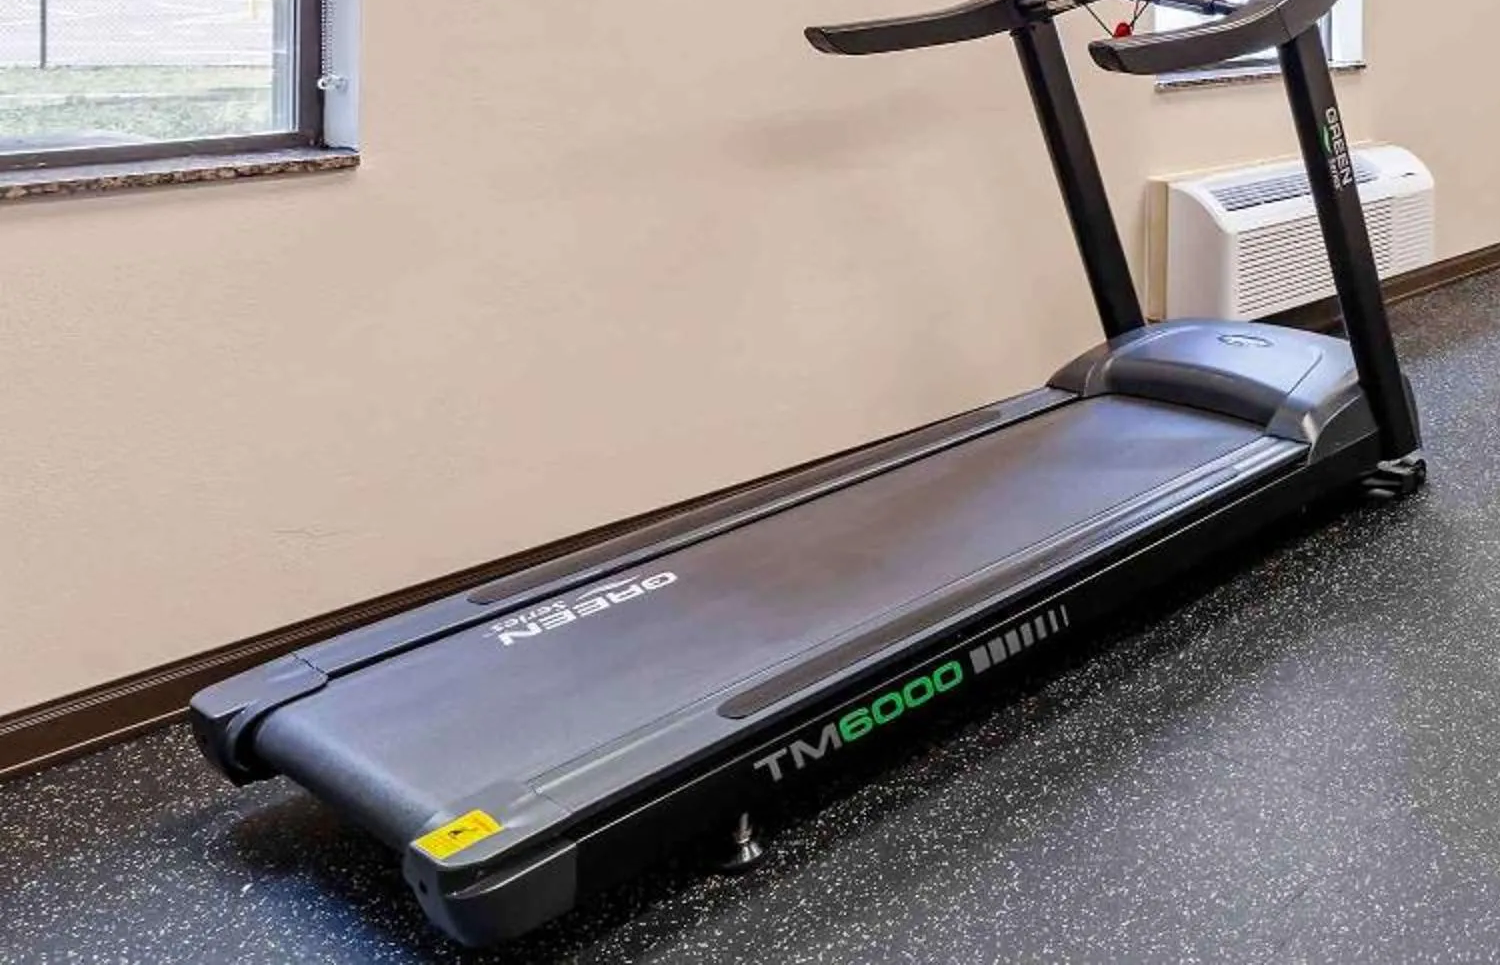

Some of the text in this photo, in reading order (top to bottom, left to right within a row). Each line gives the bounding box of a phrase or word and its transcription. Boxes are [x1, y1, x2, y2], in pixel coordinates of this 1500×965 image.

[1325, 106, 1353, 187] GREEN
[498, 571, 679, 647] GREEN
[753, 660, 964, 783] TM6000
